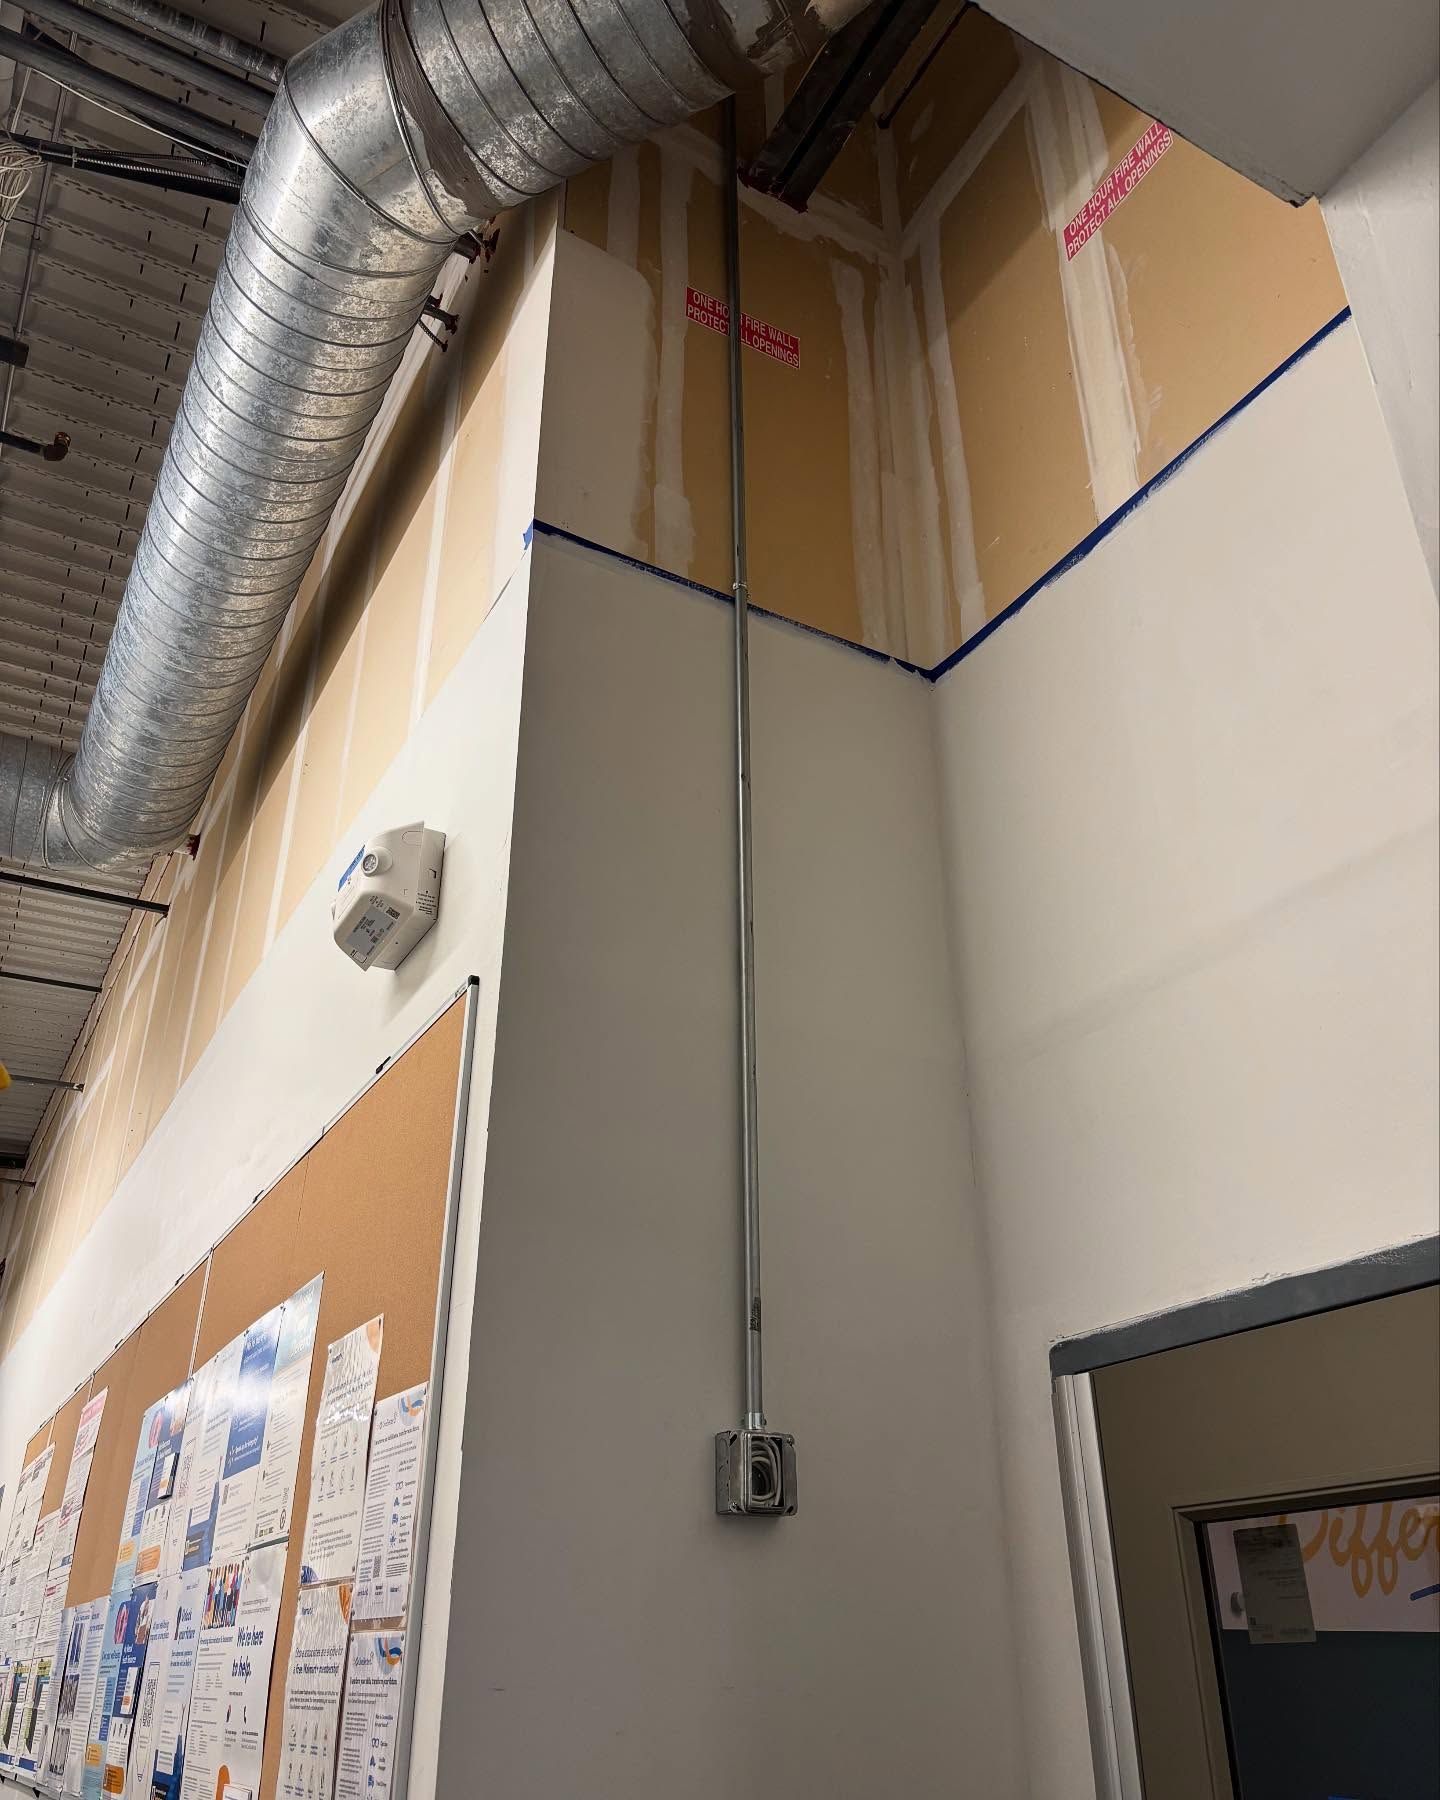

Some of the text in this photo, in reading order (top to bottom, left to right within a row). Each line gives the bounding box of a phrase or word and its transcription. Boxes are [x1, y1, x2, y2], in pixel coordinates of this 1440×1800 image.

[1067, 130, 1171, 258] PROTECT ALL OPENINGS
[1069, 123, 1163, 236] ONE HOUR FIRE WALL
[692, 291, 715, 312] ONE
[745, 317, 767, 337] FIRE
[768, 325, 794, 349] WALL
[752, 336, 799, 367] OPENINGS
[232, 1659, 239, 1676] to
